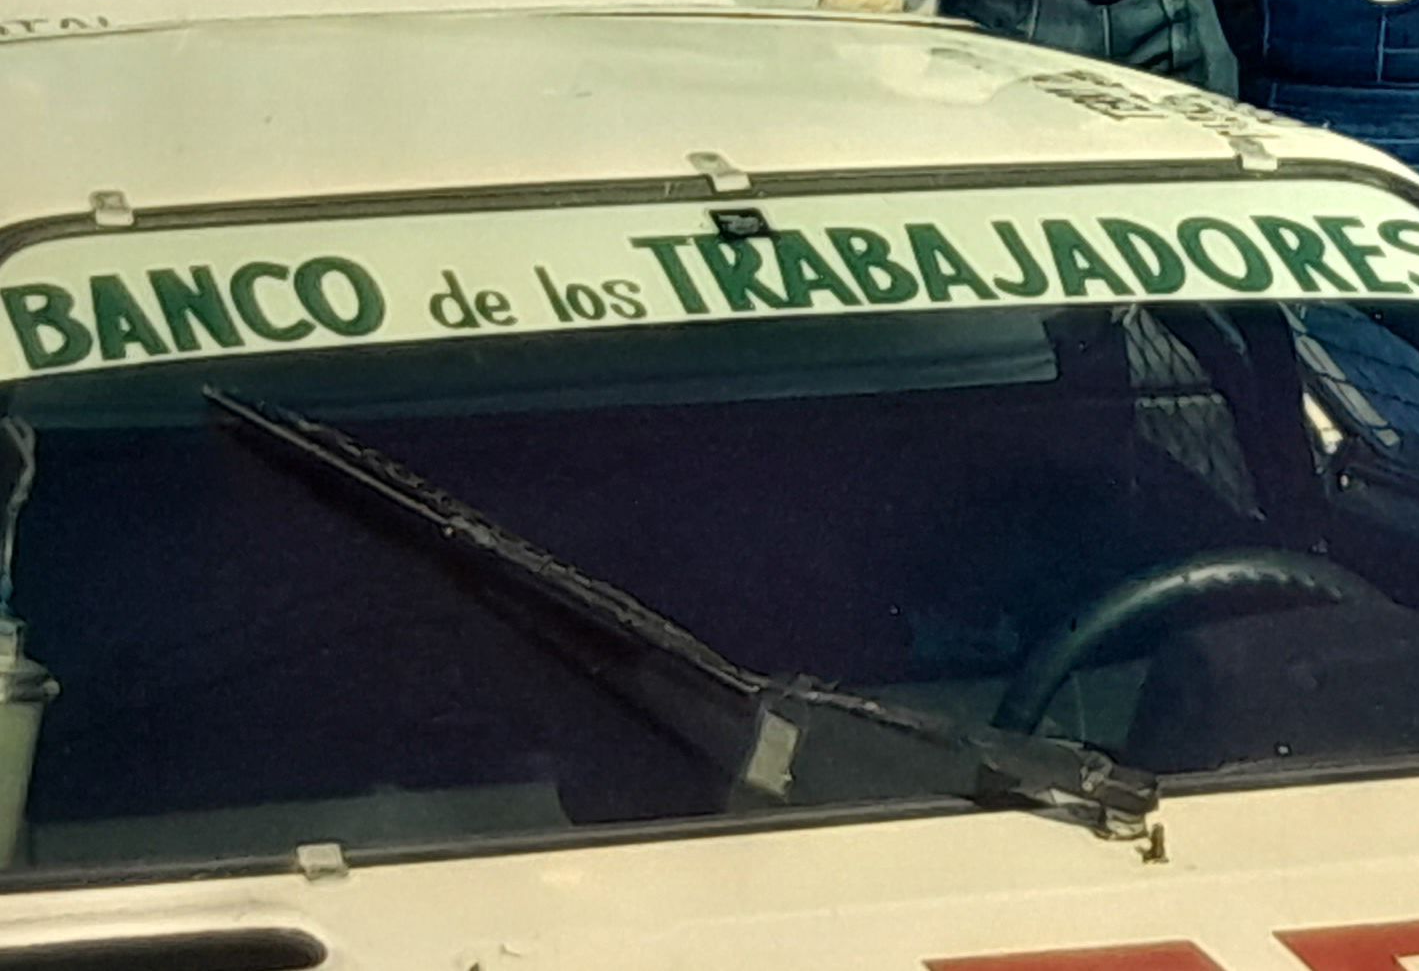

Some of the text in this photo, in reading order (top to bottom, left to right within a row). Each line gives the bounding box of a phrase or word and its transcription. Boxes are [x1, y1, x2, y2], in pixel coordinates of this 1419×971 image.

[1, 255, 387, 370] BANCO
[428, 269, 513, 329] de
[534, 265, 648, 324] los
